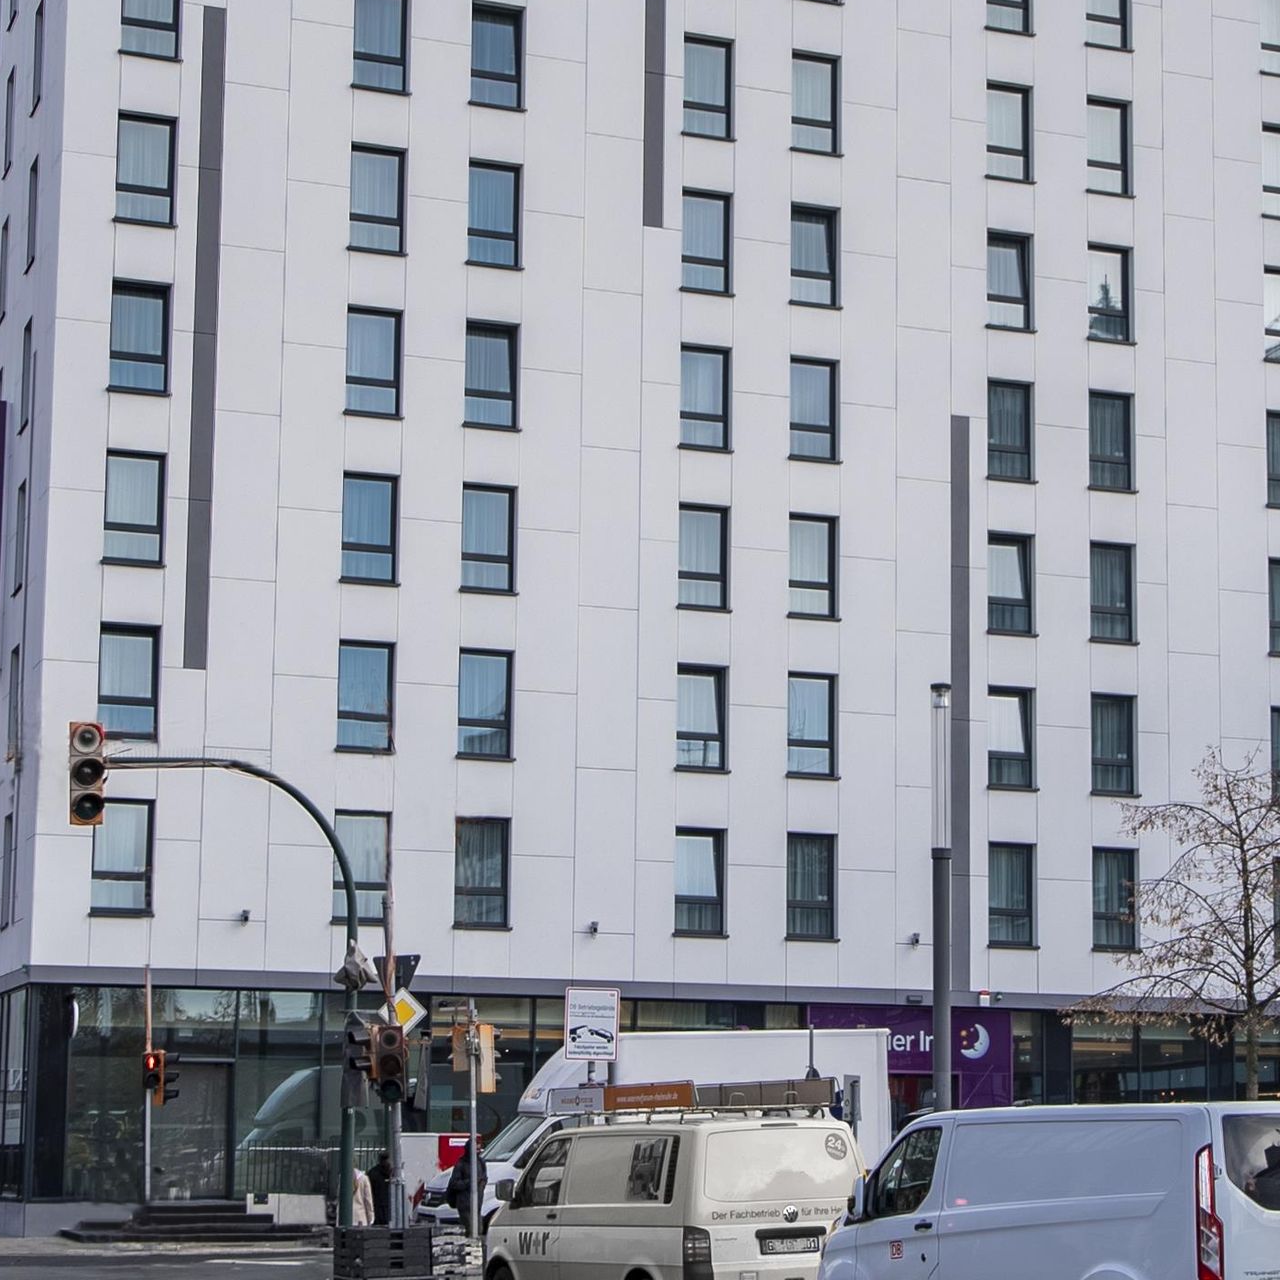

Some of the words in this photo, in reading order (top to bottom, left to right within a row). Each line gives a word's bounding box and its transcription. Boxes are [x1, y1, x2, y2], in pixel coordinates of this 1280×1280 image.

[711, 1210, 727, 1221] Der
[729, 1206, 781, 1220] Fachbetrieb
[801, 1206, 812, 1216] für
[814, 1206, 829, 1216] Ihre
[891, 1243, 902, 1256] DB
